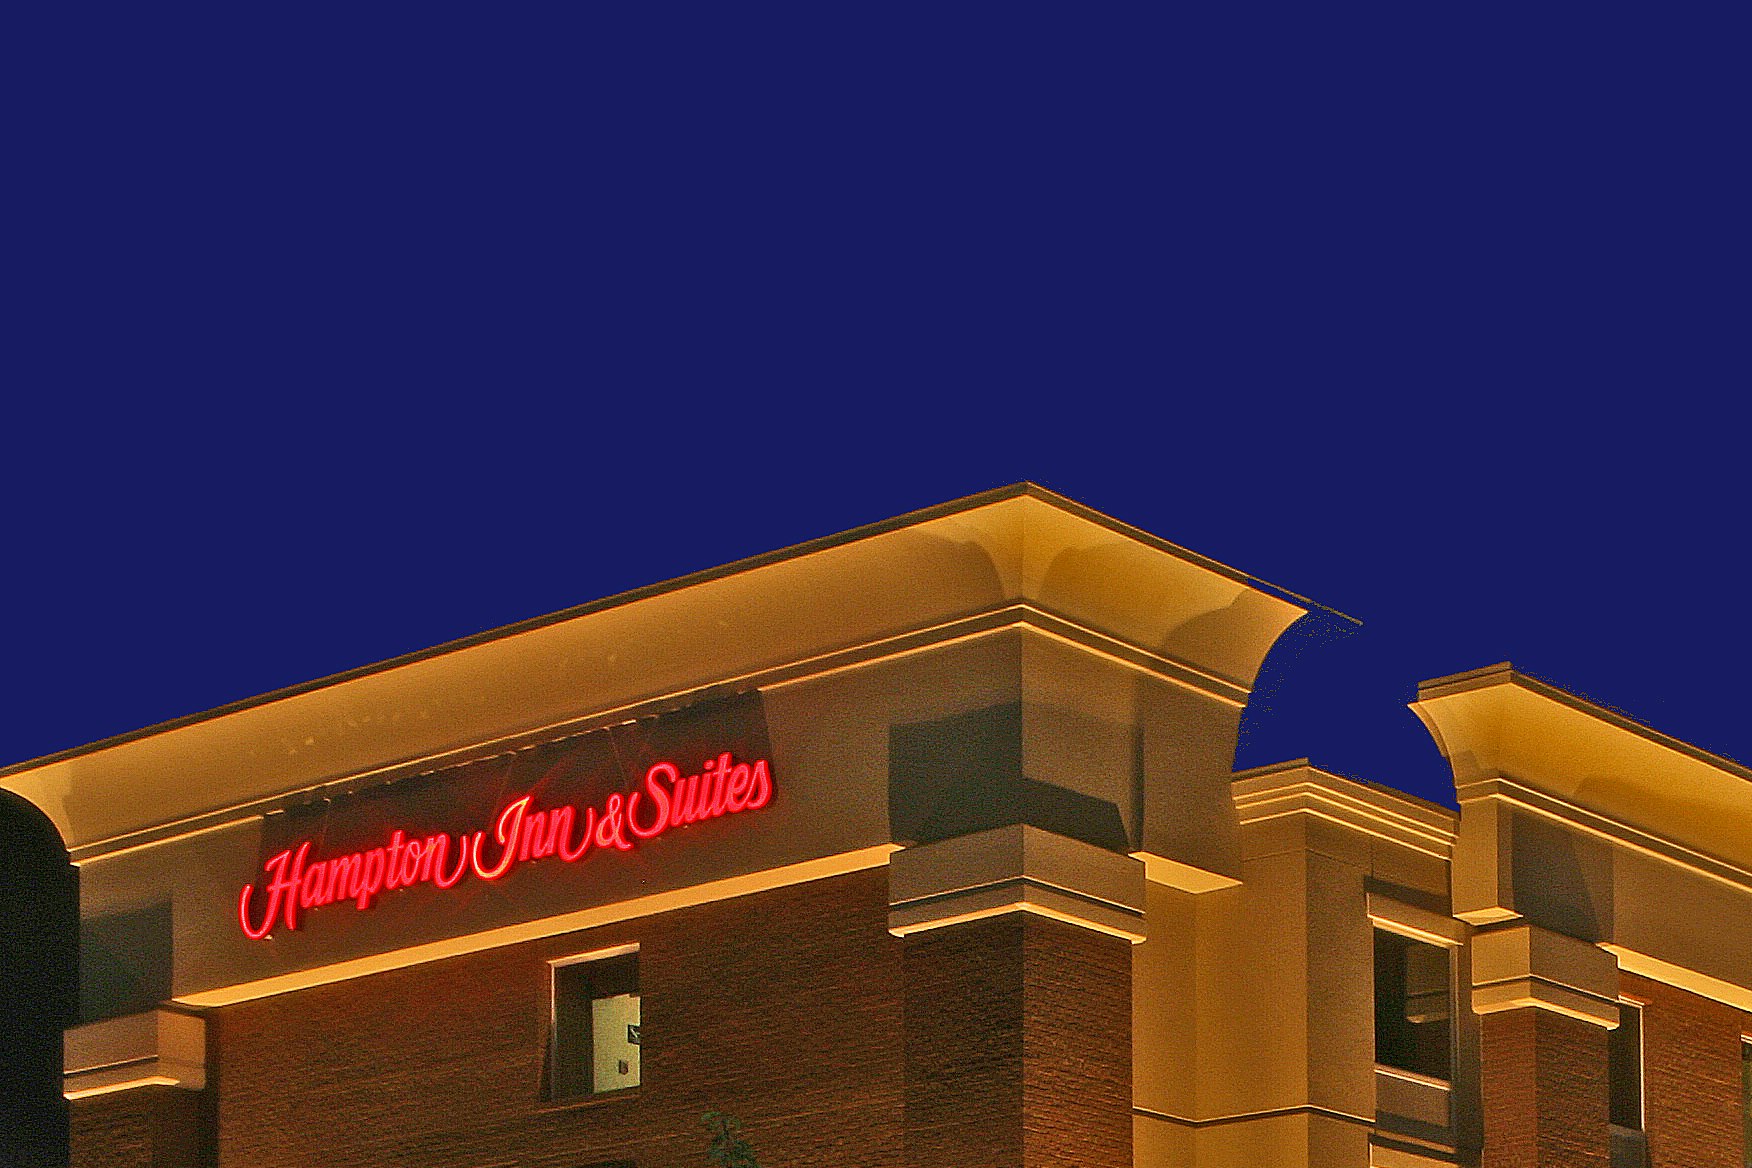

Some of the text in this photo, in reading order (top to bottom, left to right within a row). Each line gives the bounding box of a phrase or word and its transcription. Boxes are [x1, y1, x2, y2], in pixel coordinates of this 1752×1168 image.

[237, 751, 774, 941] Hampton Inn & Suites
